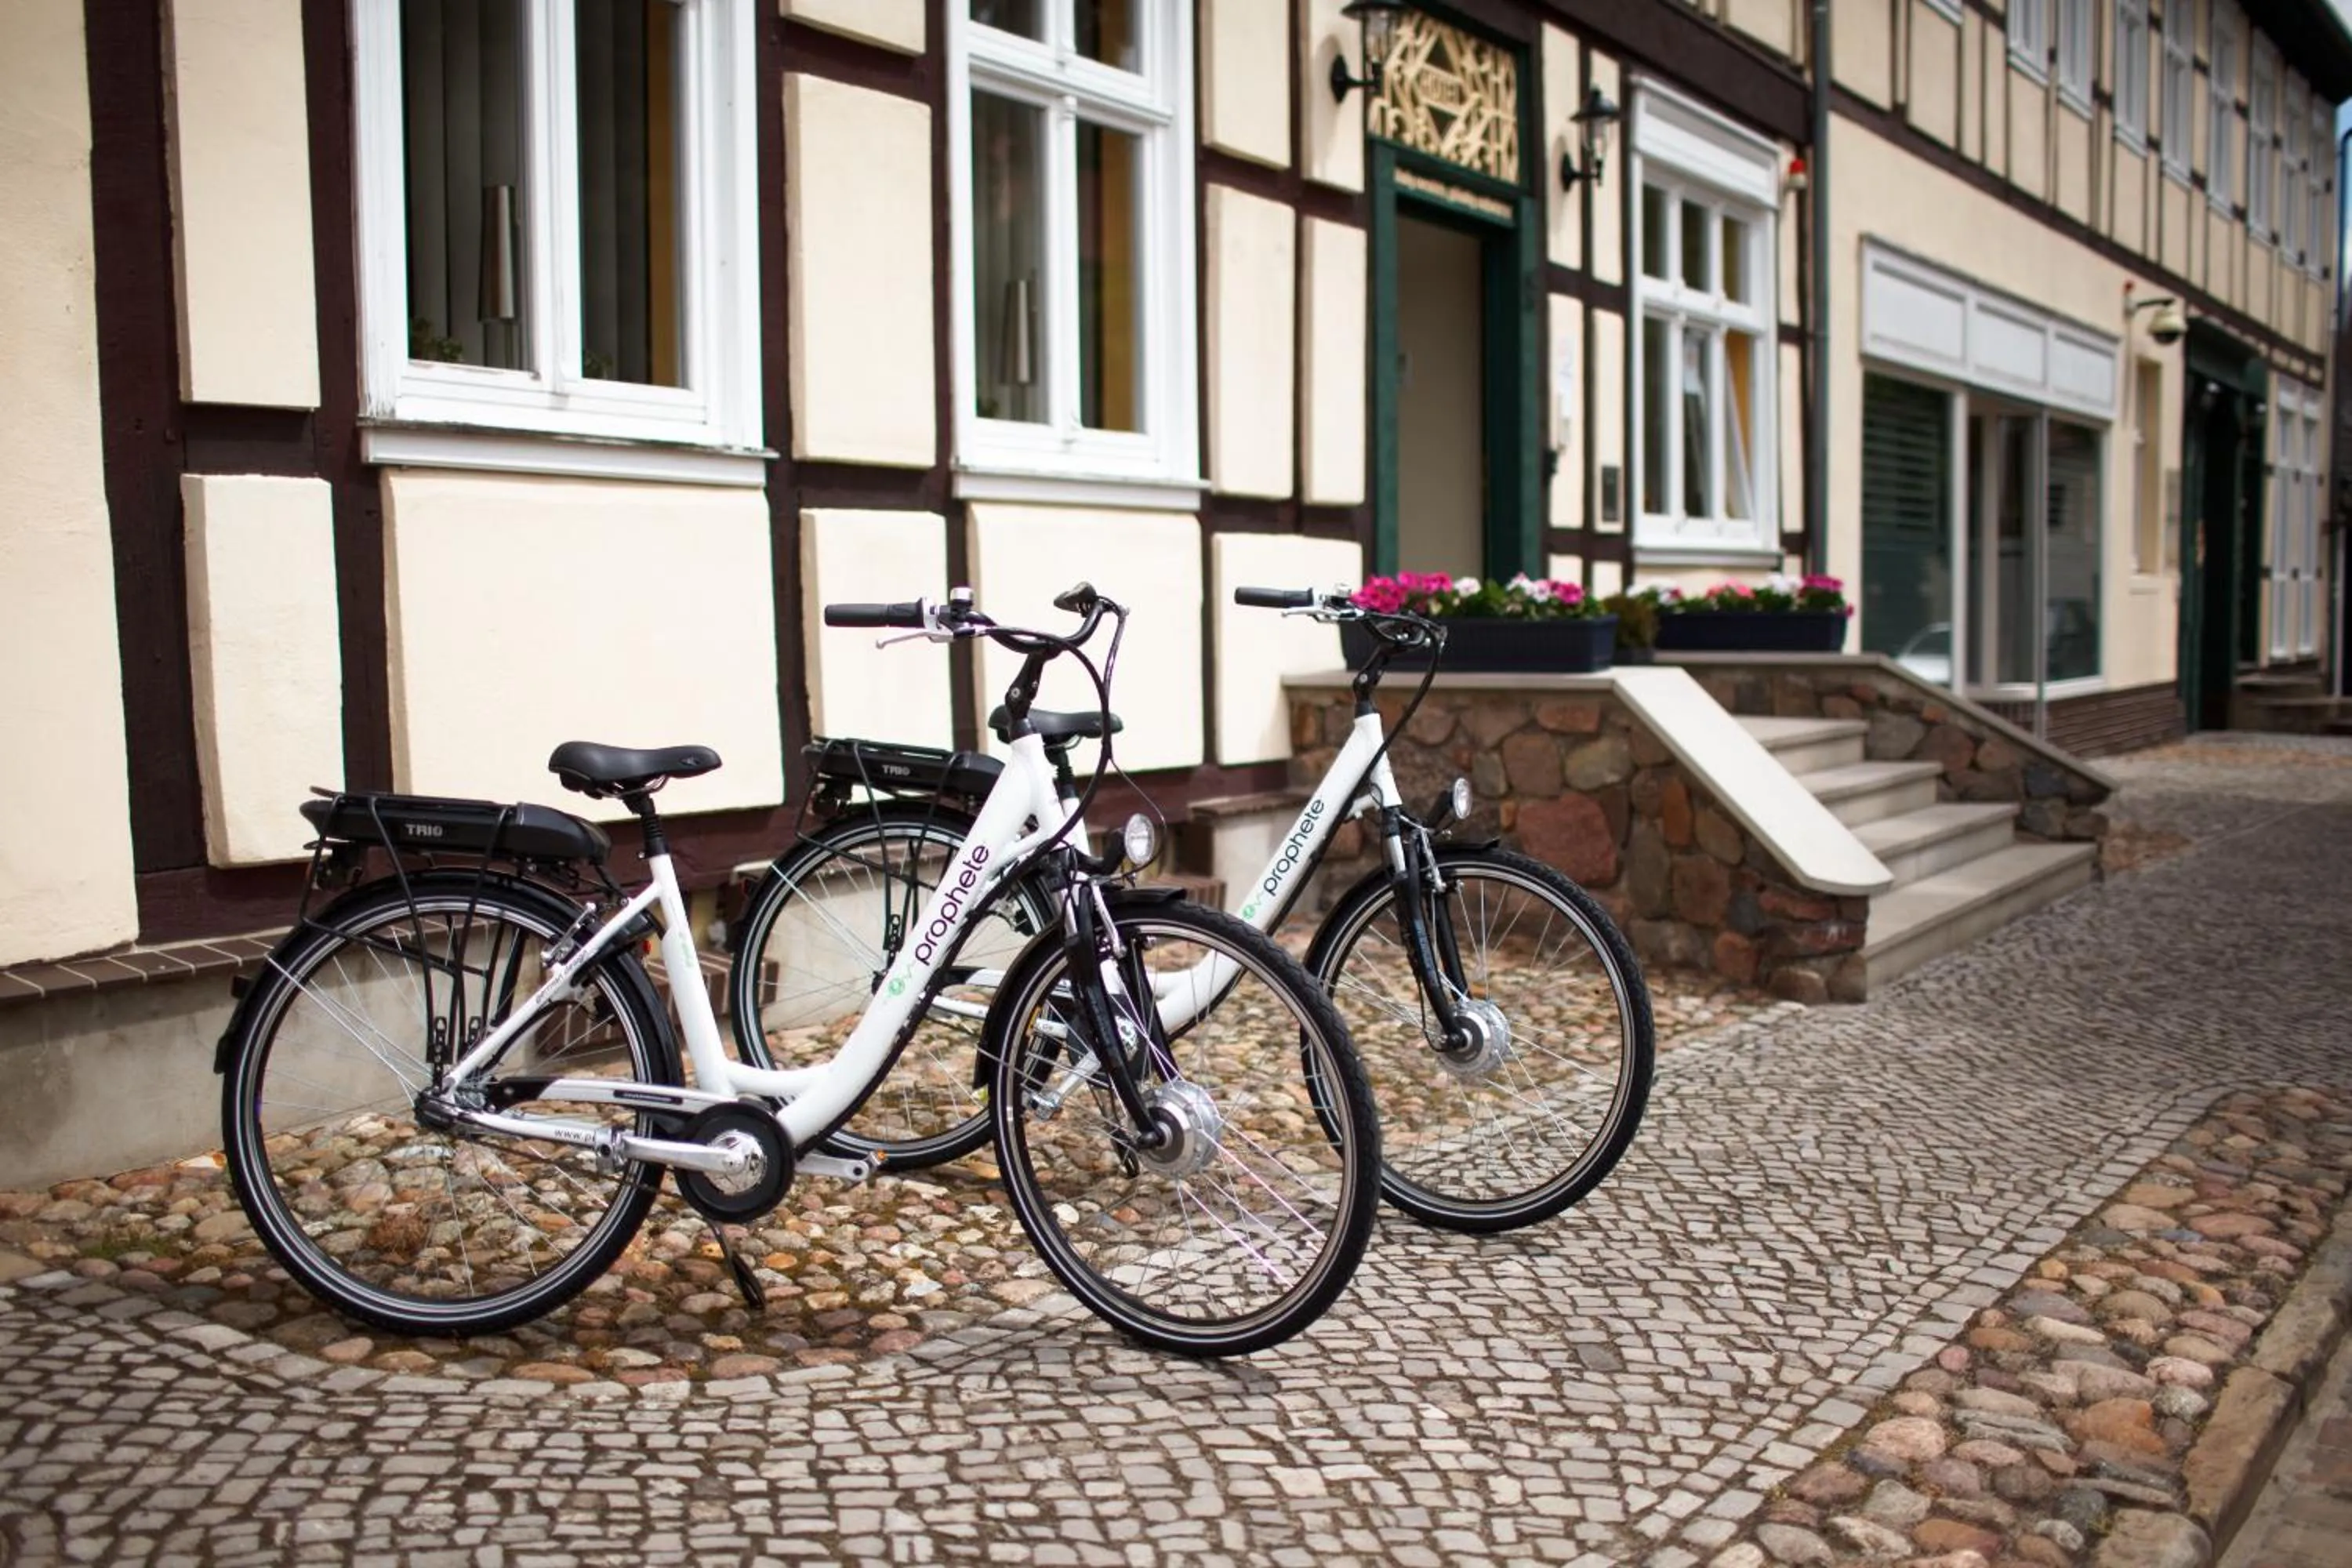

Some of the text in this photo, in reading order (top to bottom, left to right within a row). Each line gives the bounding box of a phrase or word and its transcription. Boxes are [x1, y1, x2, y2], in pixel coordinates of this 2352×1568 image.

[882, 764, 910, 776] TRIO
[404, 823, 444, 837] TRIO
[1263, 799, 1324, 897] prophete
[915, 845, 989, 967] prophete
